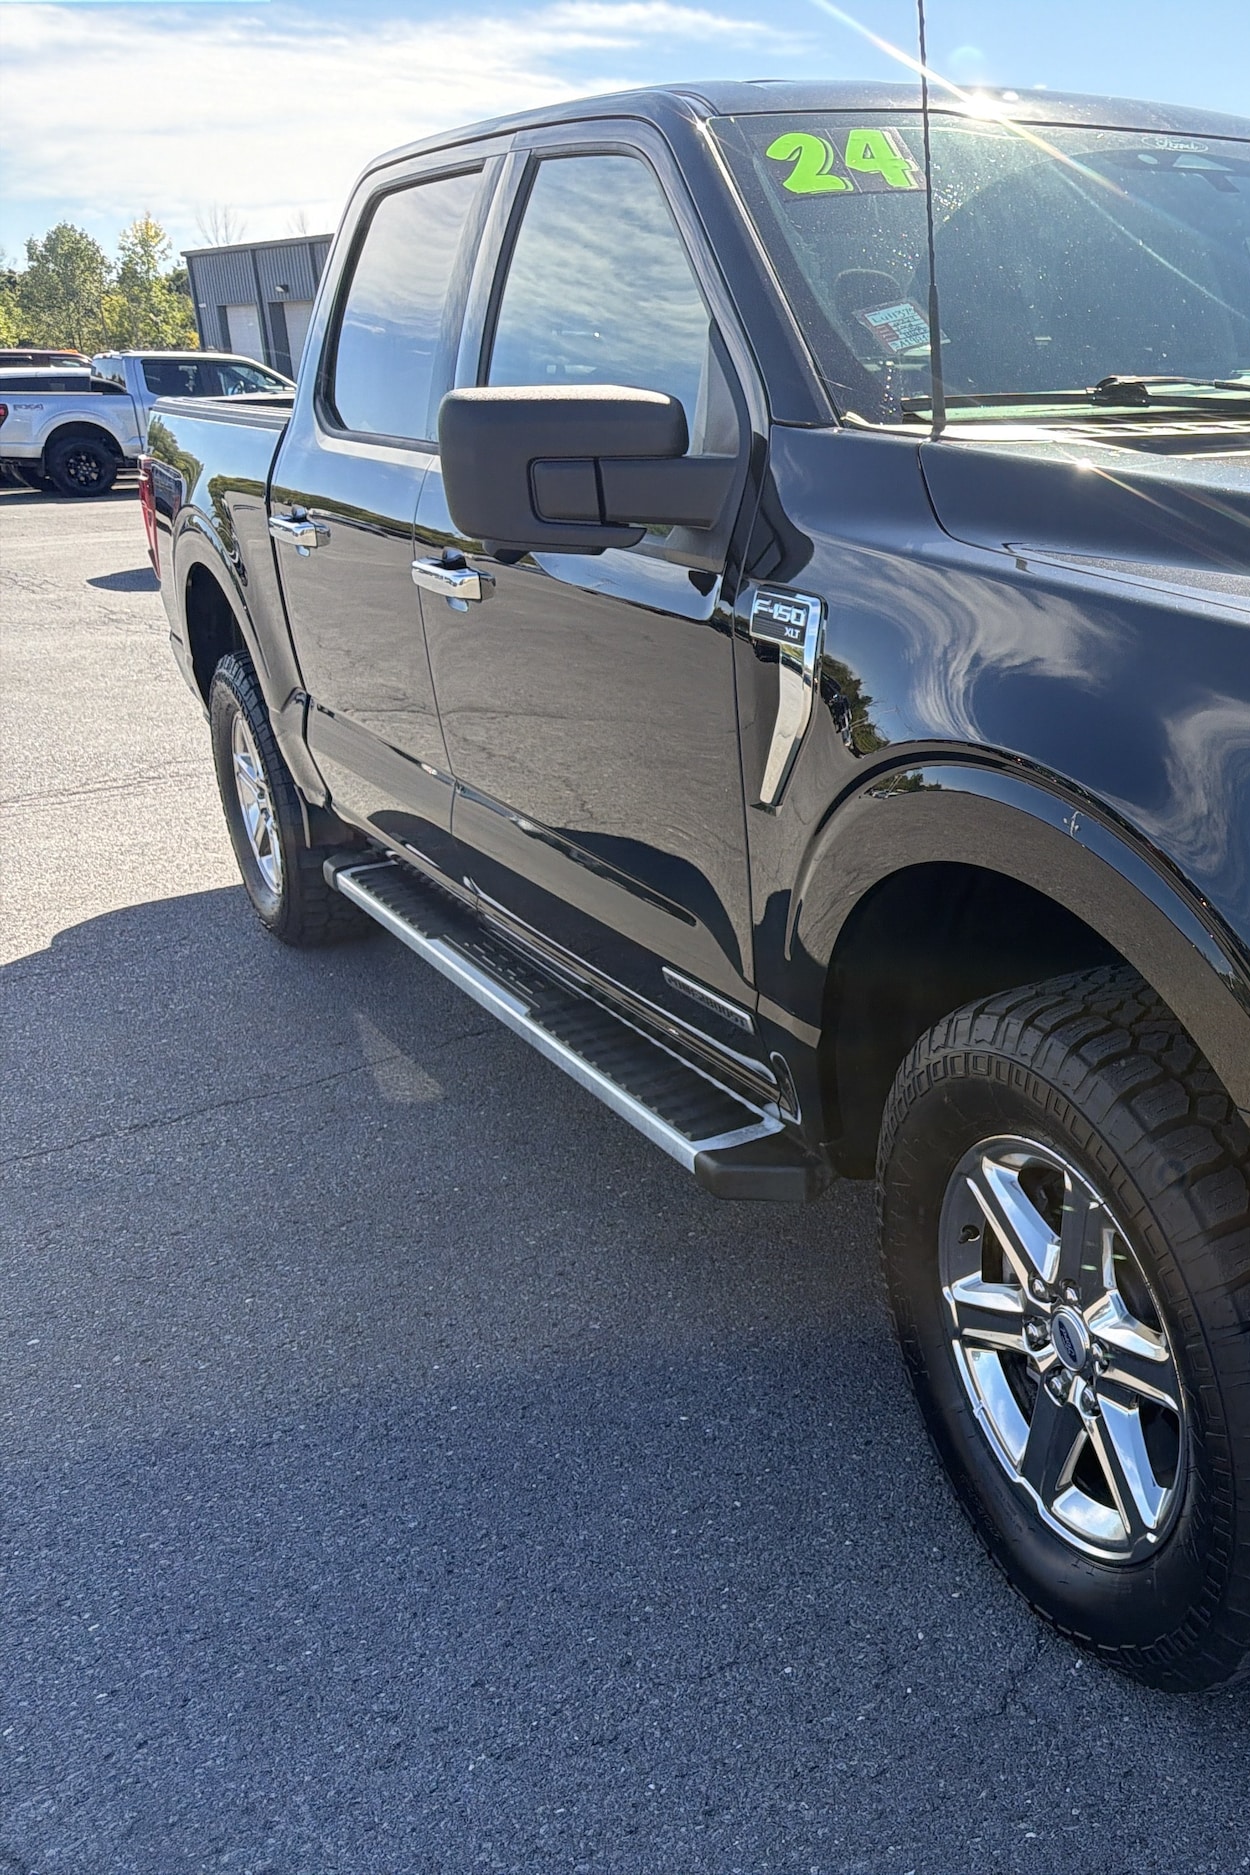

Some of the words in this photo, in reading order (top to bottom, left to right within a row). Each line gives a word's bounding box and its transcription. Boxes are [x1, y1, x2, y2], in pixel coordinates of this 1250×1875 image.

[766, 128, 921, 194] 24
[753, 599, 807, 627] F-150
[784, 626, 801, 639] XLT
